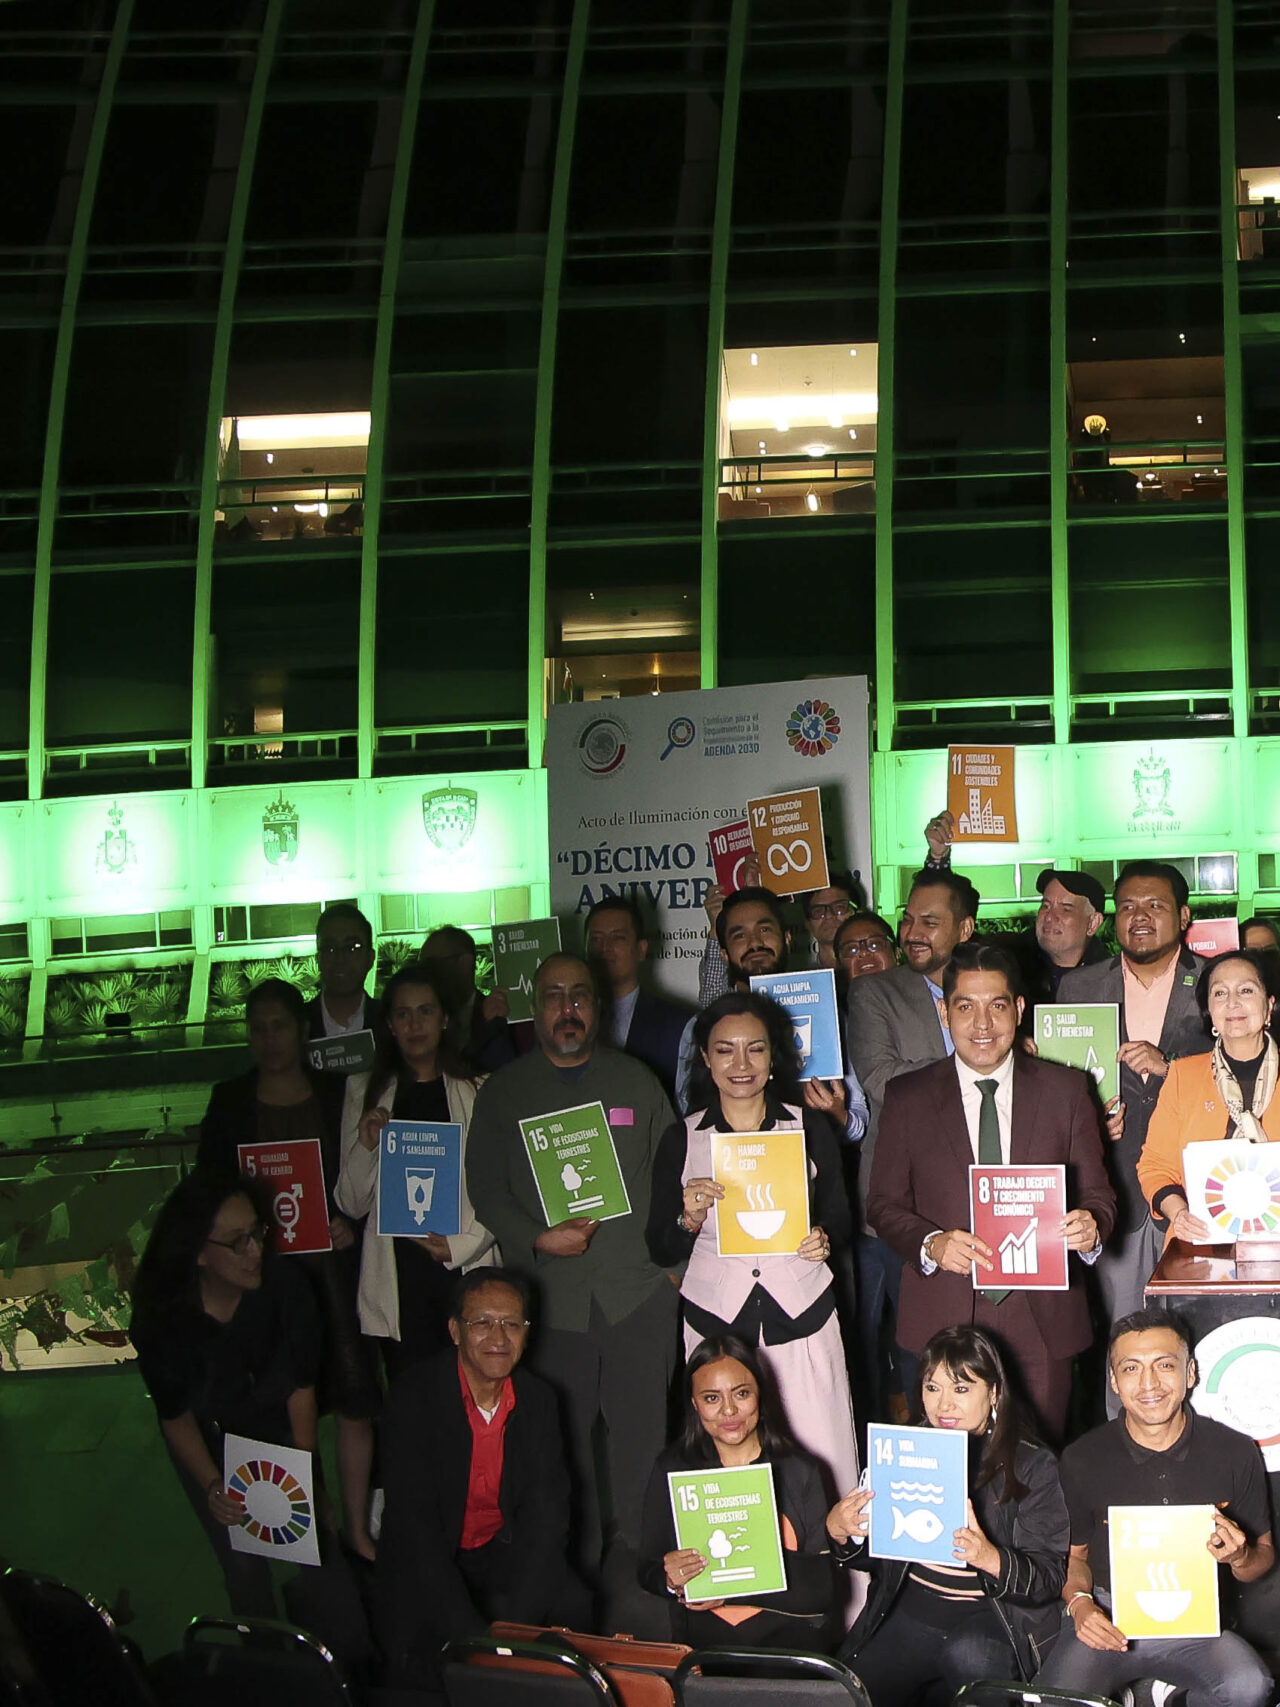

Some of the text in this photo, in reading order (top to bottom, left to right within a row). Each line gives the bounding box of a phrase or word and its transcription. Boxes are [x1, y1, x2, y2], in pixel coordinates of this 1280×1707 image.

[952, 754, 963, 775] 11
[578, 814, 607, 830] Acto
[610, 812, 625, 826] de
[629, 806, 709, 826] Iluminación
[713, 809, 739, 820] con
[752, 807, 767, 828] 12
[773, 823, 809, 837] RESPONSABLES
[713, 834, 728, 856] 10
[498, 931, 506, 954] 3
[772, 982, 789, 995] AGUA
[790, 981, 811, 993] LIMPIA
[779, 993, 819, 1006] SANEAMIENTO
[1043, 1014, 1052, 1039] 3
[1056, 1014, 1077, 1025] SALUD
[1056, 1027, 1061, 1037] Y
[387, 1130, 396, 1155] 6
[401, 1131, 438, 1143] AGUA LIMPIA
[529, 1127, 550, 1152] 15
[722, 1145, 733, 1172] 2
[737, 1144, 767, 1156] HAMBRE
[246, 1155, 257, 1177] 5
[979, 1177, 991, 1204] 8
[993, 1177, 1057, 1190] TRABAJO DECENTE
[994, 1190, 1045, 1203] Y CRECIMIENTO
[874, 1437, 895, 1466] 14
[677, 1485, 700, 1513] 15
[703, 1483, 720, 1495] VIDA
[705, 1493, 762, 1508] DE ECOSISTEMAS
[707, 1510, 749, 1525] TERRESTRES
